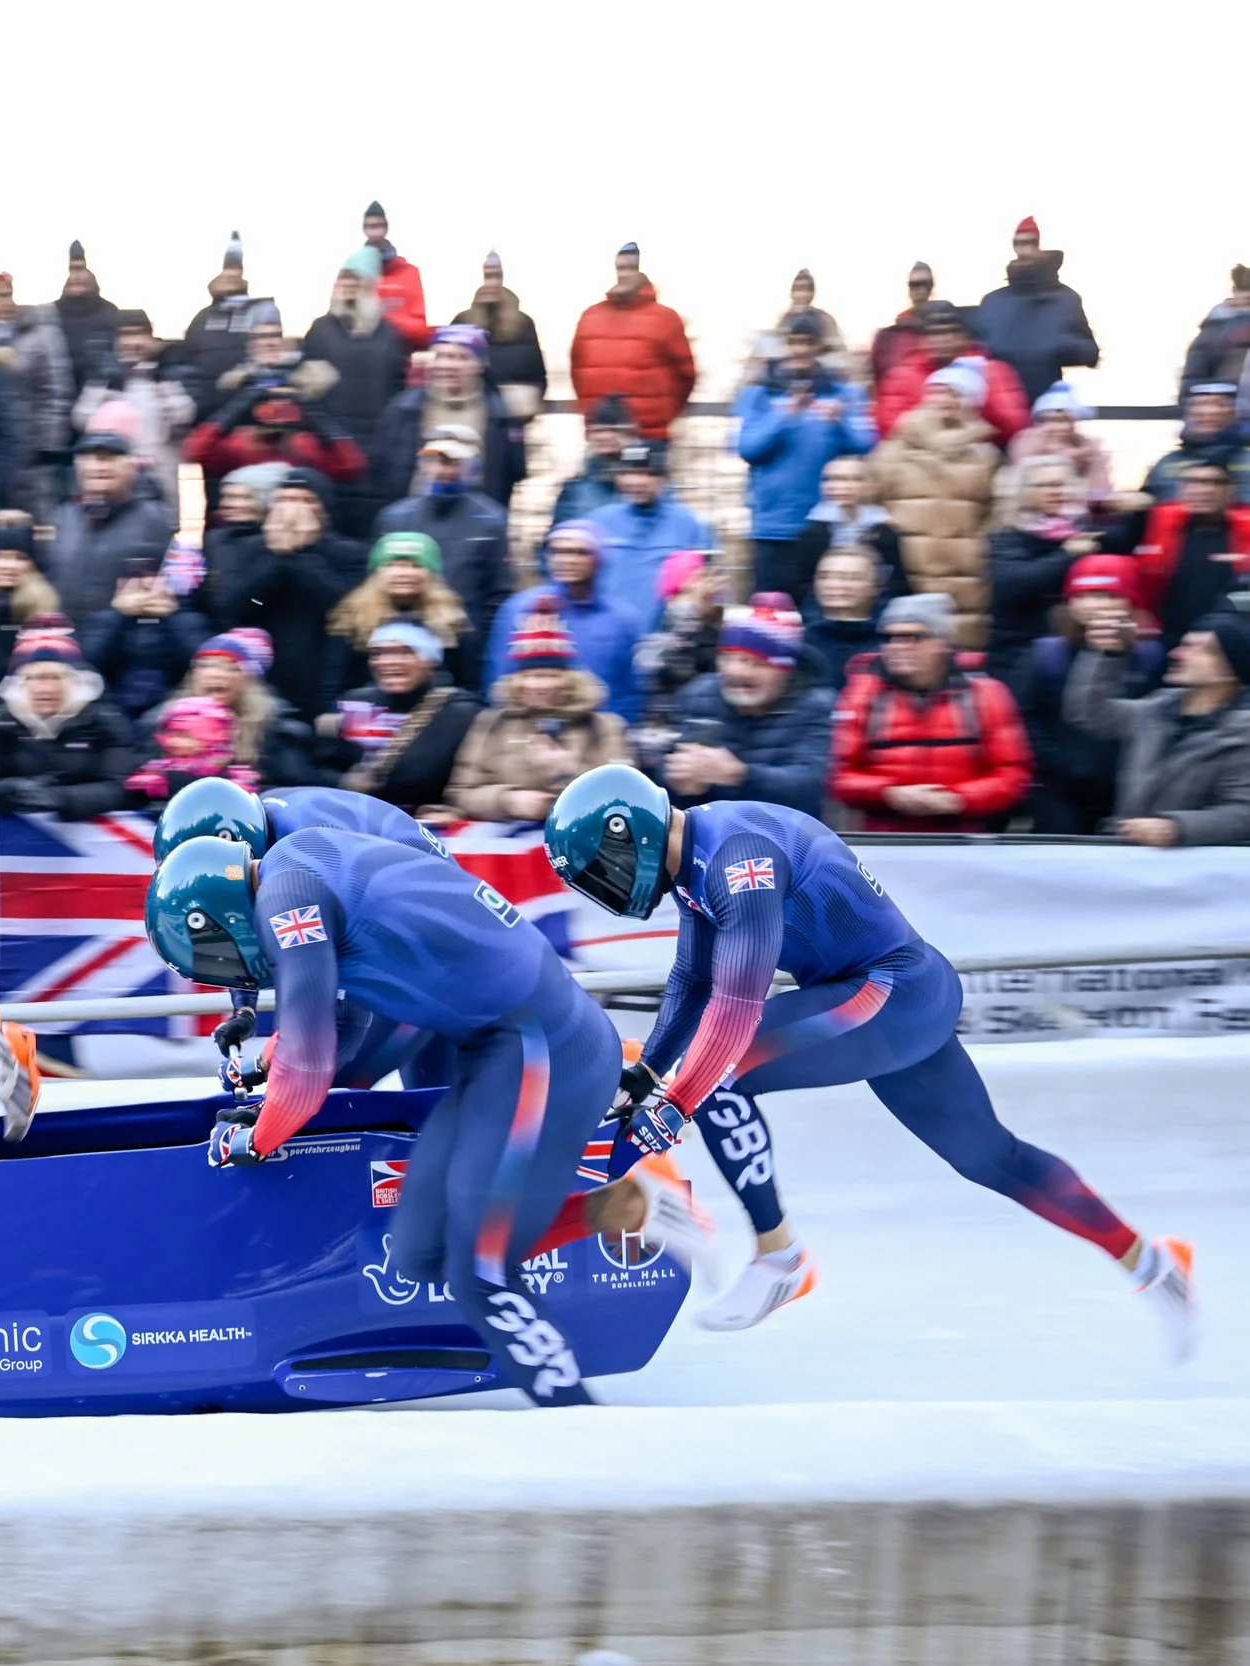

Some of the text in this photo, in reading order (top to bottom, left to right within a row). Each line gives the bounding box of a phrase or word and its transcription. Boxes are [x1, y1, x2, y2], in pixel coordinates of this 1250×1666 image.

[638, 1125, 663, 1151] SEIZ
[708, 1091, 772, 1192] GBR
[592, 1268, 676, 1283] TEAM HALL
[611, 1280, 656, 1289] BOBSLEIGH
[131, 1331, 186, 1346] SIRKKA
[0, 1358, 43, 1373] Group
